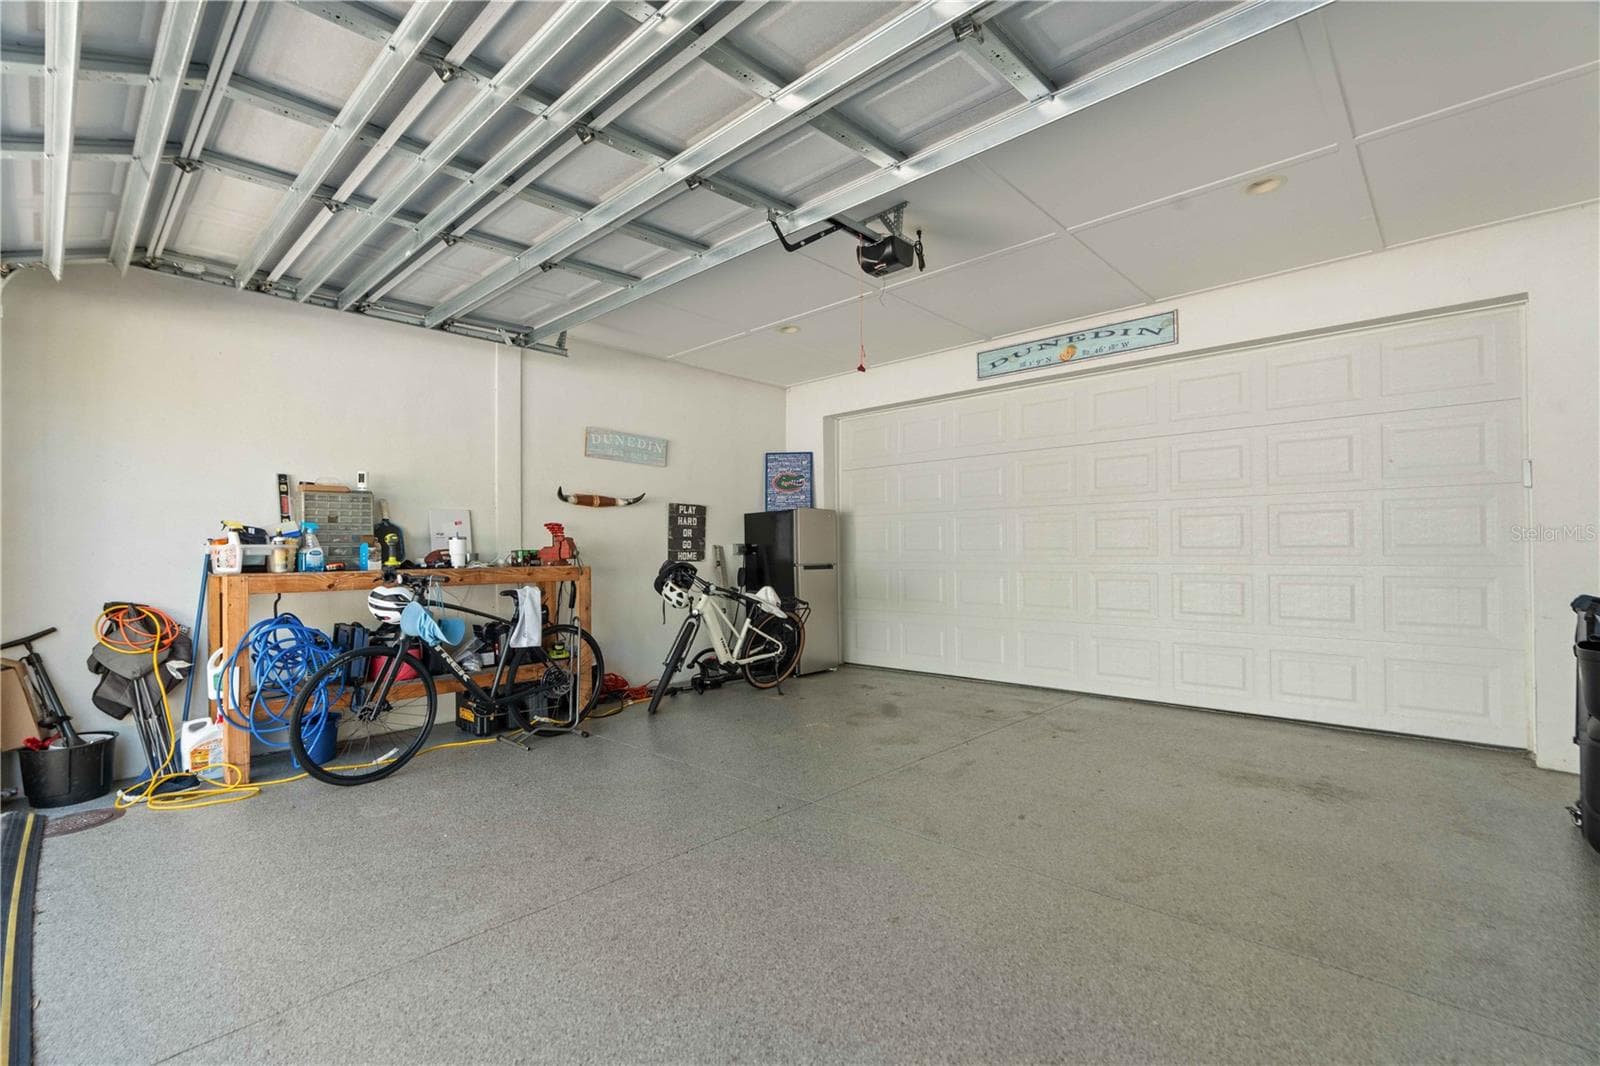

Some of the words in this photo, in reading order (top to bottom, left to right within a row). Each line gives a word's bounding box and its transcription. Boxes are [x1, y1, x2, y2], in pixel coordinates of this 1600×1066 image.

[990, 326, 1164, 369] DUNEDIN
[591, 433, 666, 453] DUNEDIN
[679, 505, 696, 514] PLAY
[677, 516, 697, 526] HARD
[682, 528, 692, 538] OR
[682, 540, 692, 549] GO
[677, 551, 697, 561] HOME
